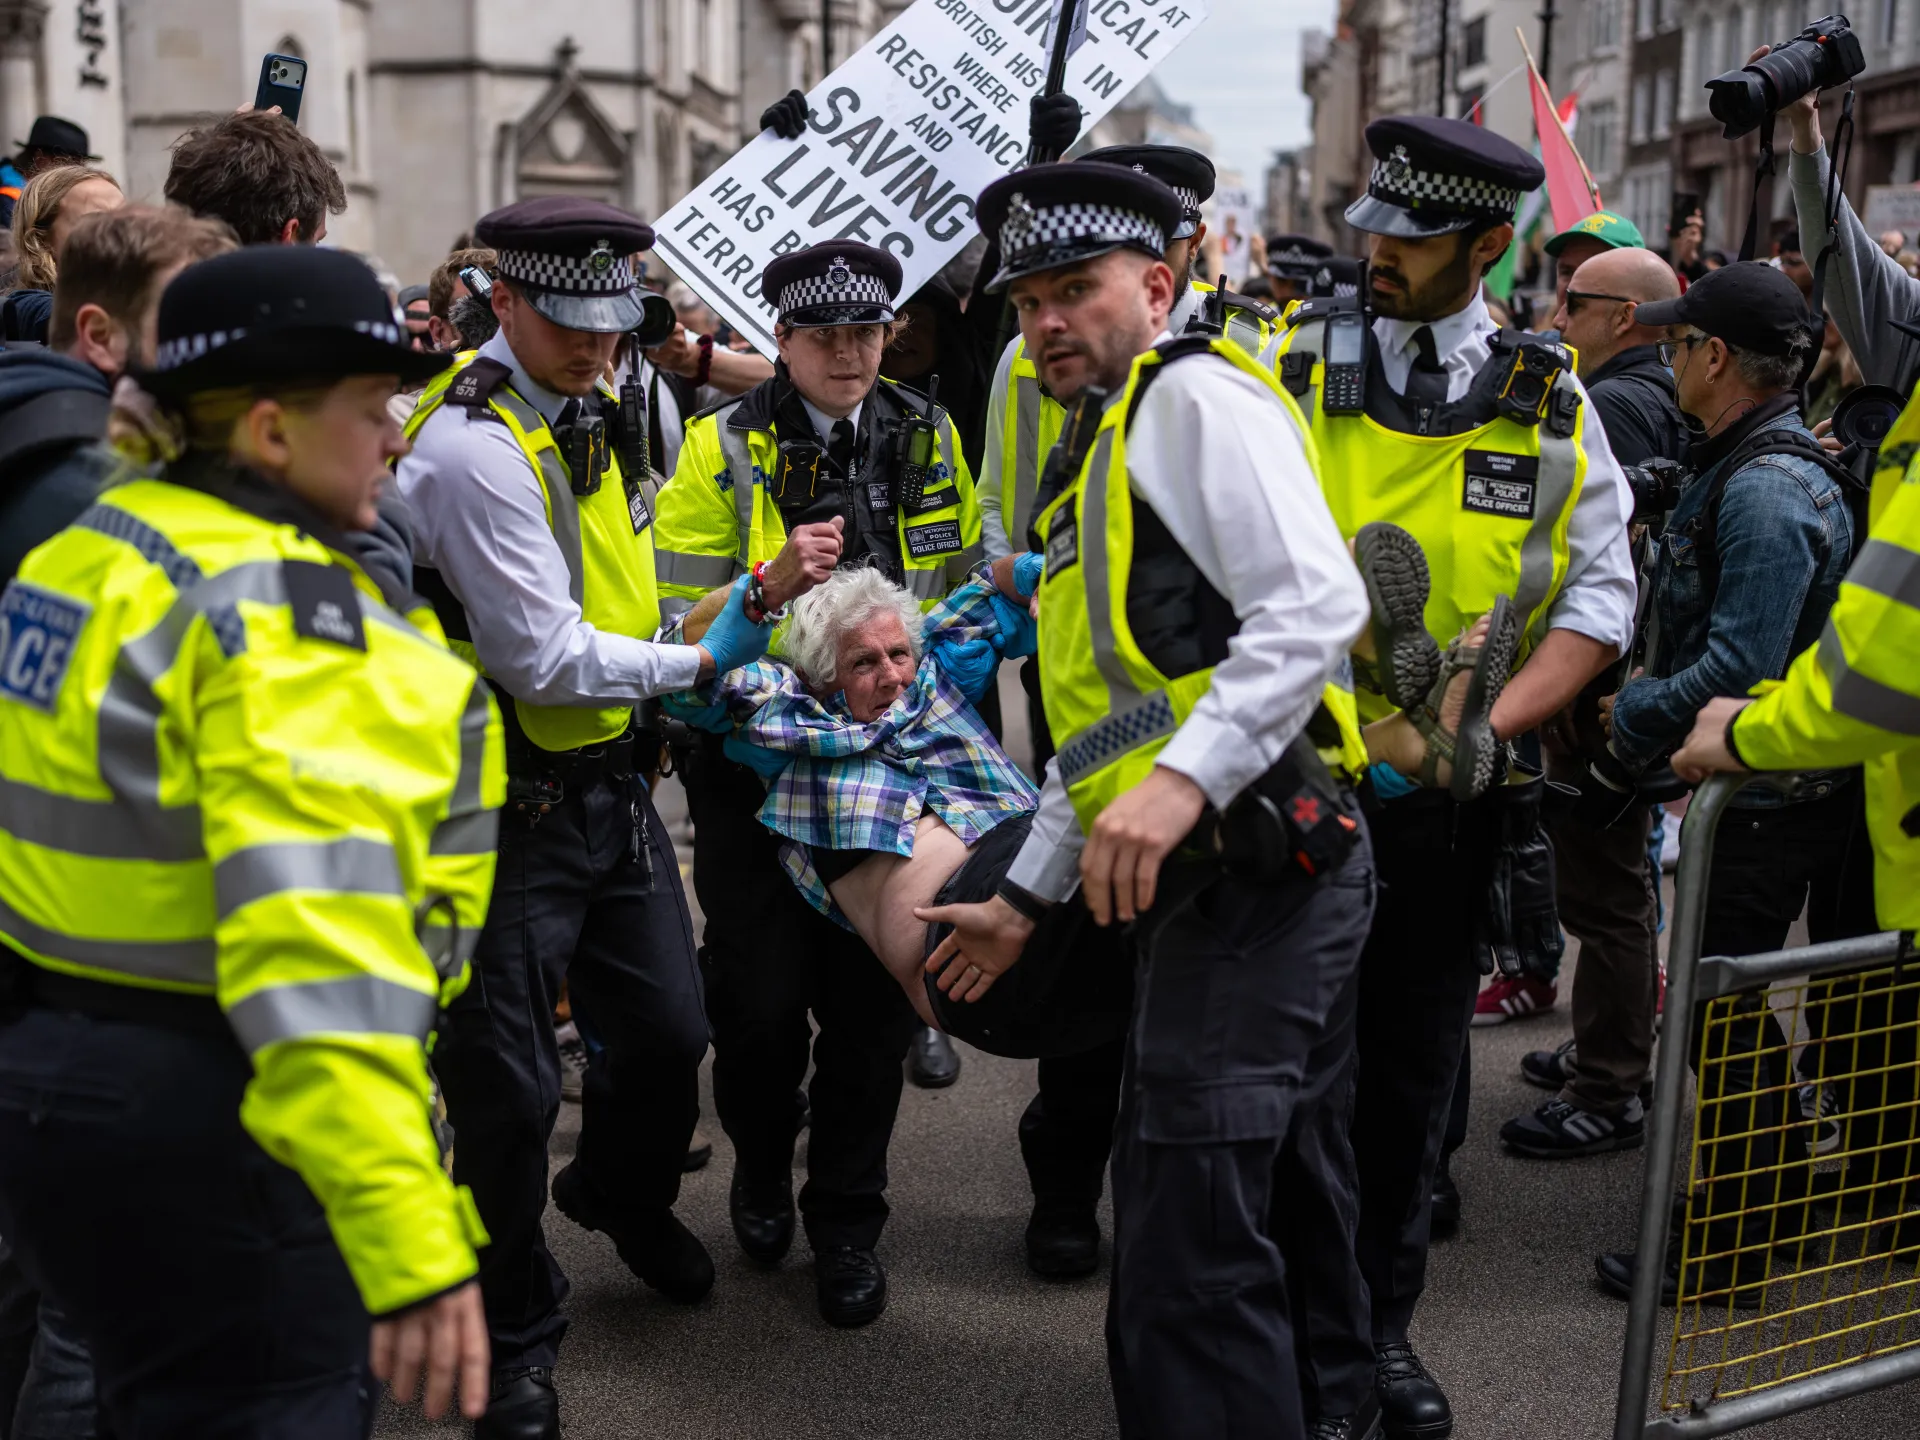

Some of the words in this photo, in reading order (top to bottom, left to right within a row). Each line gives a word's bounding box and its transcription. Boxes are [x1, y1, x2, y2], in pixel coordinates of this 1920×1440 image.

[1158, 6, 1191, 28] AT
[1089, 0, 1160, 60] ICAL
[953, 52, 1020, 114] WHERE
[1082, 63, 1123, 100] IN
[904, 113, 953, 153] AND
[807, 86, 976, 242] SAVING
[709, 176, 775, 233] HAS
[673, 205, 776, 318] TERRO
[463, 376, 478, 386] NA
[455, 385, 477, 397] 1575
[1489, 482, 1527, 492] METROPOLITAN
[1494, 489, 1521, 499] POLICE
[1467, 496, 1493, 508] POLICE
[1495, 502, 1529, 513] OFFICER
[924, 525, 955, 535] METROPOLITAN
[929, 532, 952, 540] POLICE
[912, 543, 936, 554] POLICE
[936, 539, 960, 550] OFFICER
